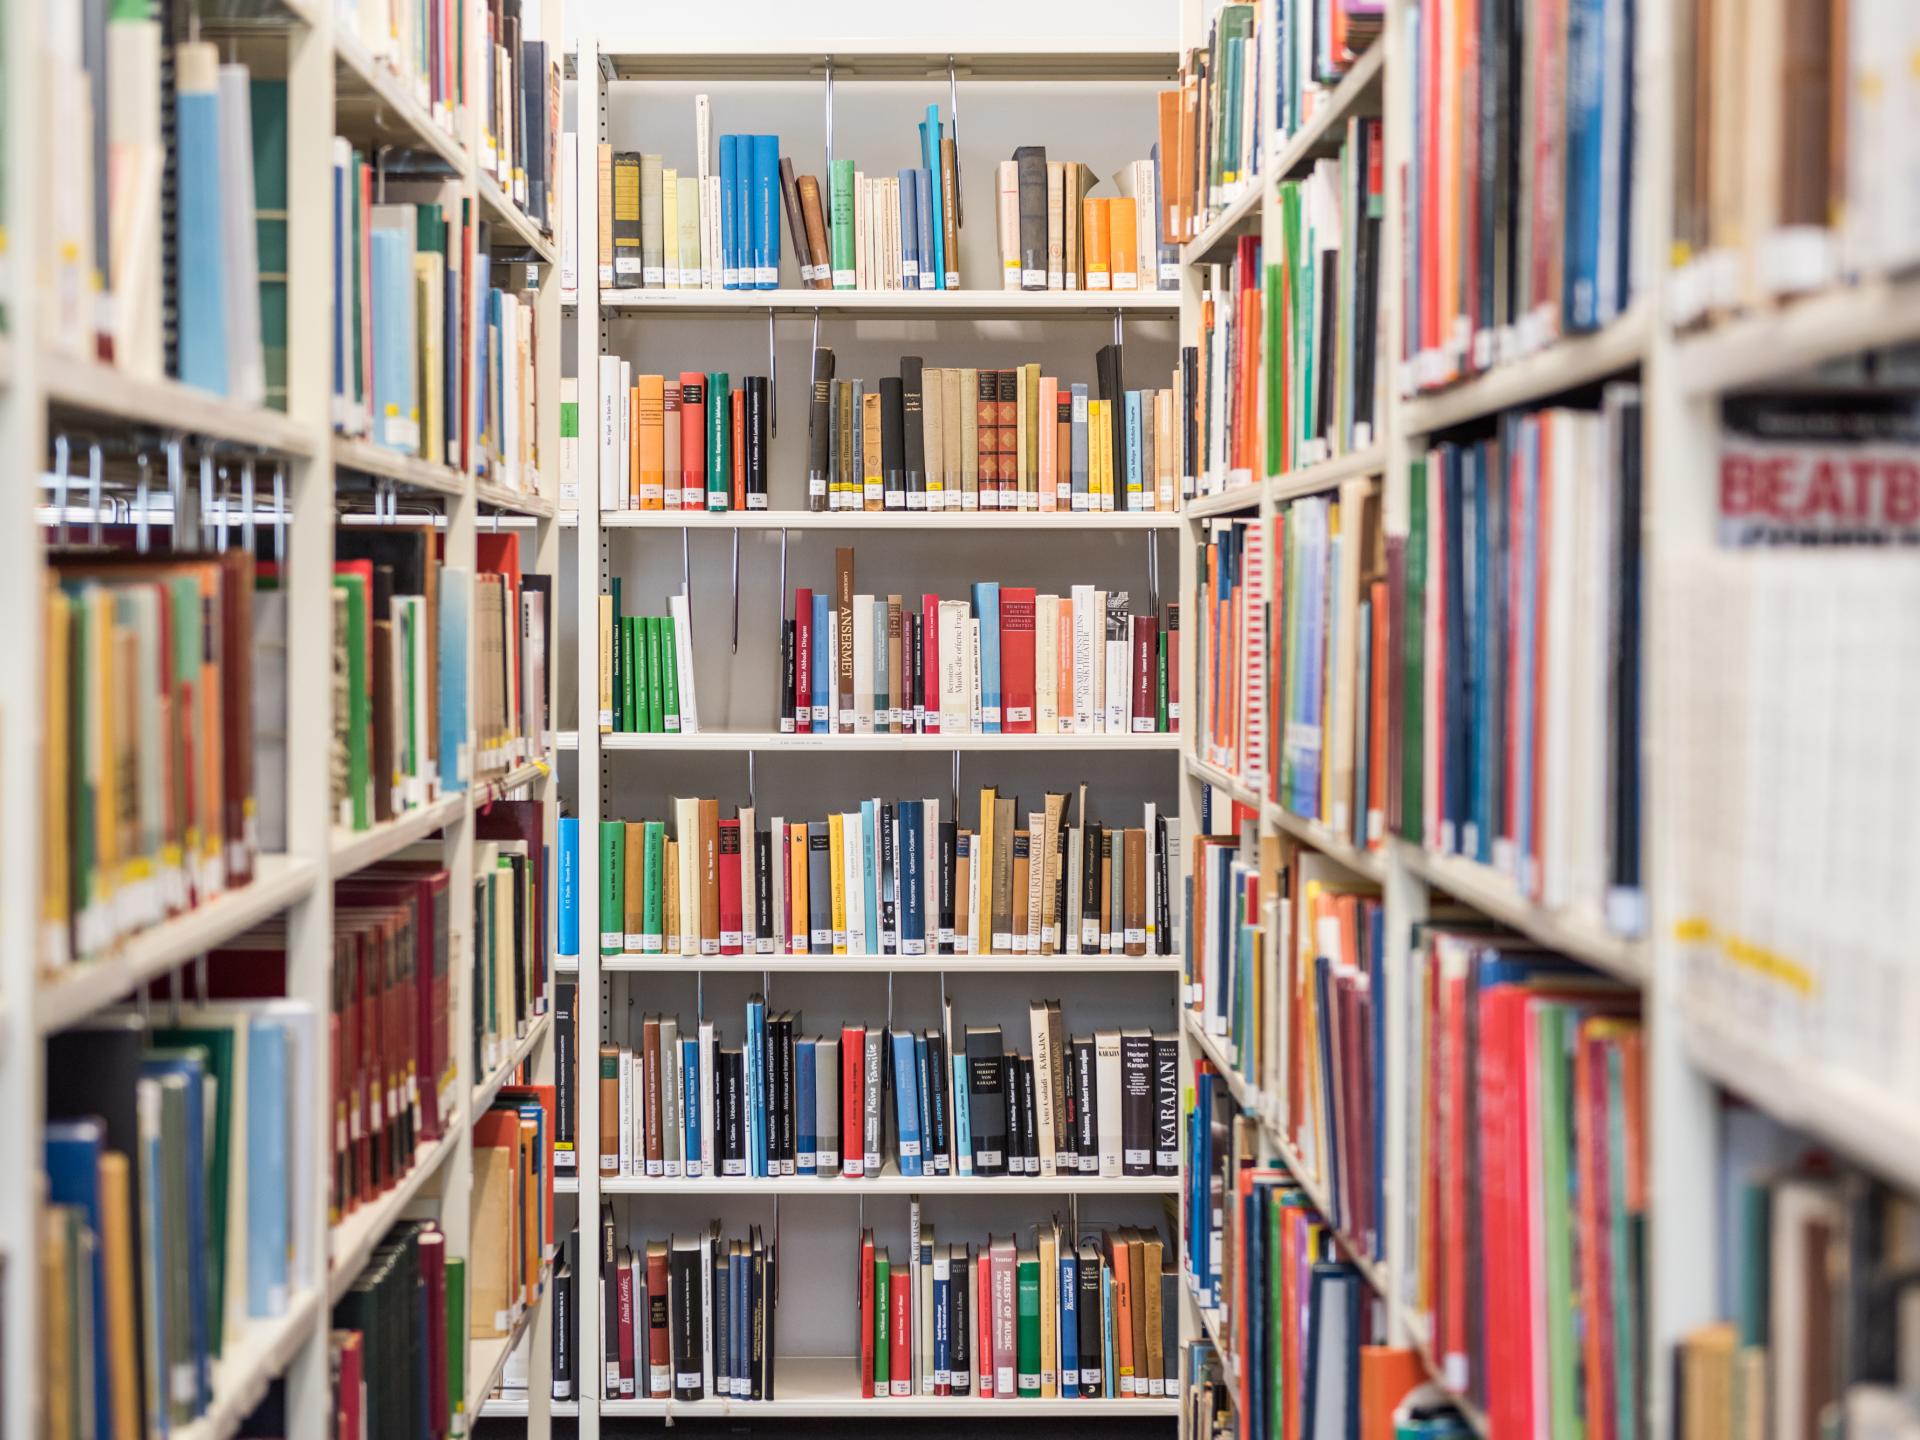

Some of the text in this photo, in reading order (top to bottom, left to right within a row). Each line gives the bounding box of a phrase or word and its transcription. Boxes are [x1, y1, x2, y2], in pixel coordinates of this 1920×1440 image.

[954, 608, 964, 629] Frage
[840, 606, 852, 679] ANSERMET
[946, 664, 954, 694] Bernstein
[1082, 632, 1090, 696] MUSIKTHEATER
[832, 883, 842, 928] Riccardo Chailly
[768, 1037, 776, 1072] Interpretation
[782, 1036, 790, 1072] Interpretation
[1038, 1032, 1048, 1070] KARAJAN
[1080, 1050, 1089, 1075] Karajan
[866, 1044, 878, 1114] Meine Familie
[728, 1094, 737, 1120] Unbedingt
[768, 1084, 776, 1111] Werktreue
[1082, 1090, 1090, 1113] Herbert
[1160, 1060, 1177, 1148] KARAJAN
[1042, 1108, 1050, 1126] Peter
[1083, 1113, 1092, 1145] Robinson,
[606, 1246, 614, 1263] Rudolf
[912, 1211, 920, 1263] KURT MASUR
[1004, 1270, 1012, 1351] PRIEST OF MUSIC
